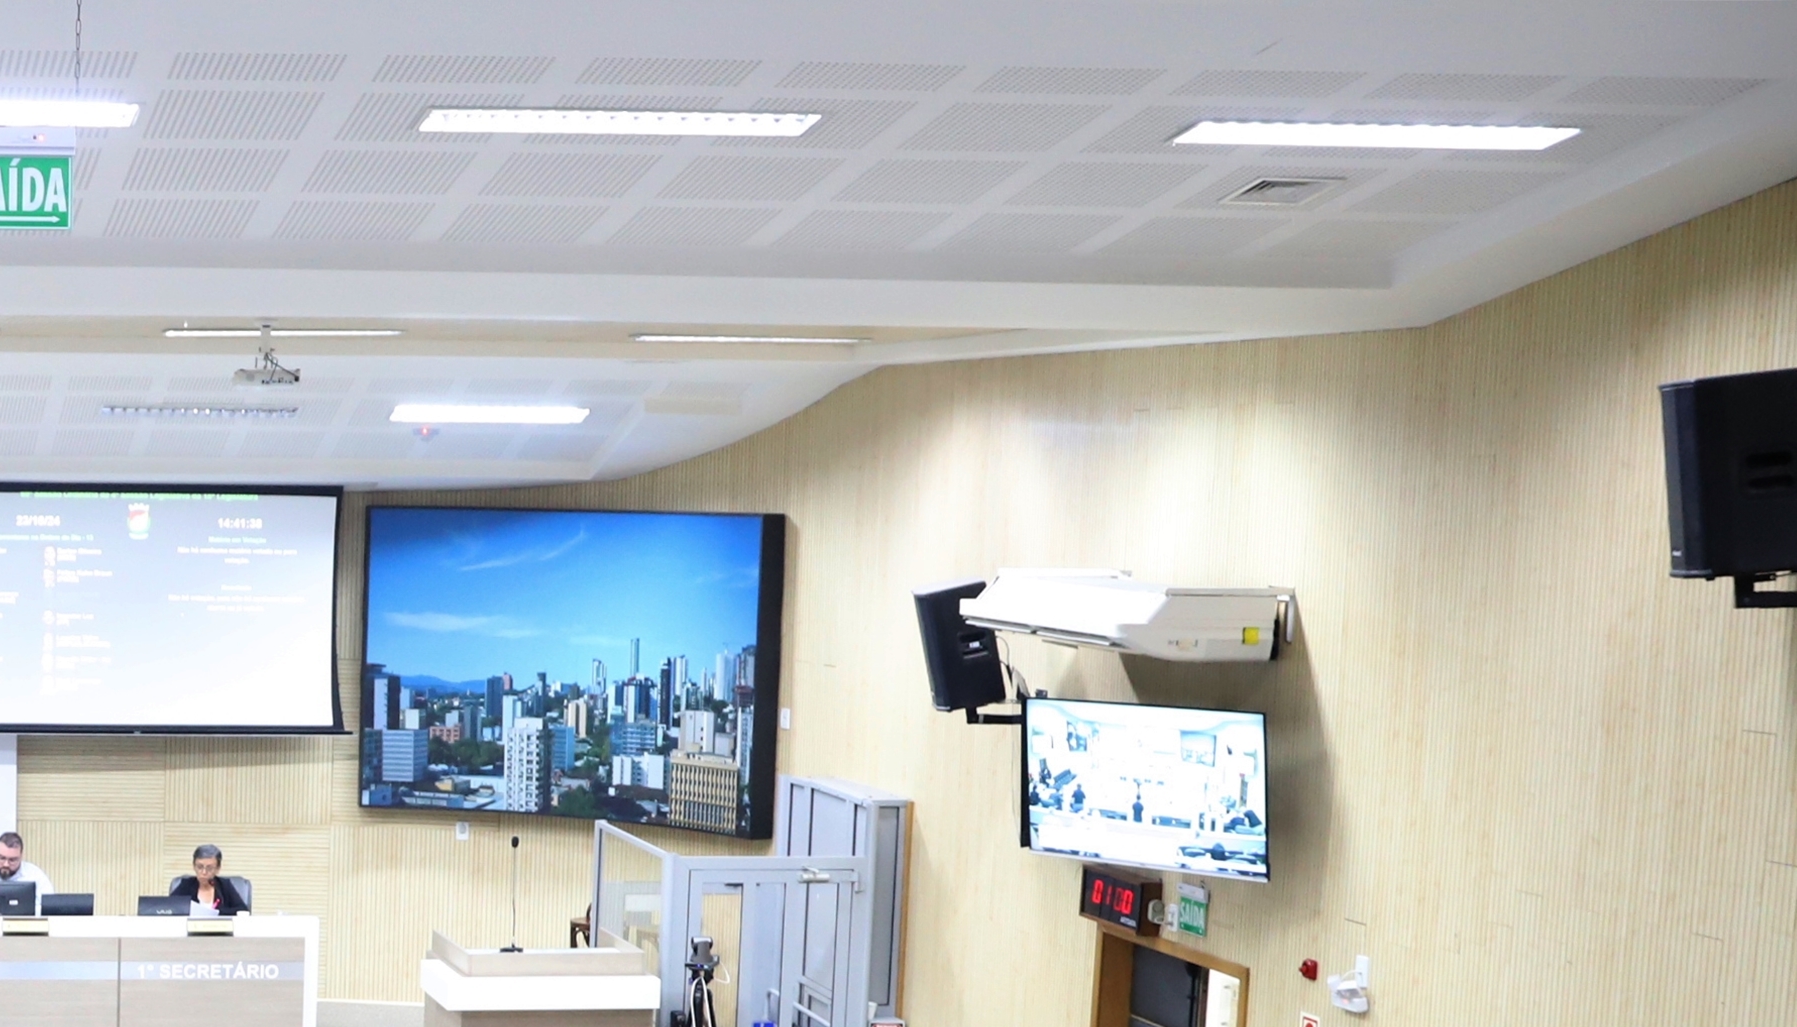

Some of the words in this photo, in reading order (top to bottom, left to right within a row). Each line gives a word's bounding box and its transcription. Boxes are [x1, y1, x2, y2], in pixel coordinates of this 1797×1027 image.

[1179, 897, 1205, 928] SAÍDA
[137, 963, 154, 979] 1º
[159, 961, 280, 979] SECRETÁRIO
